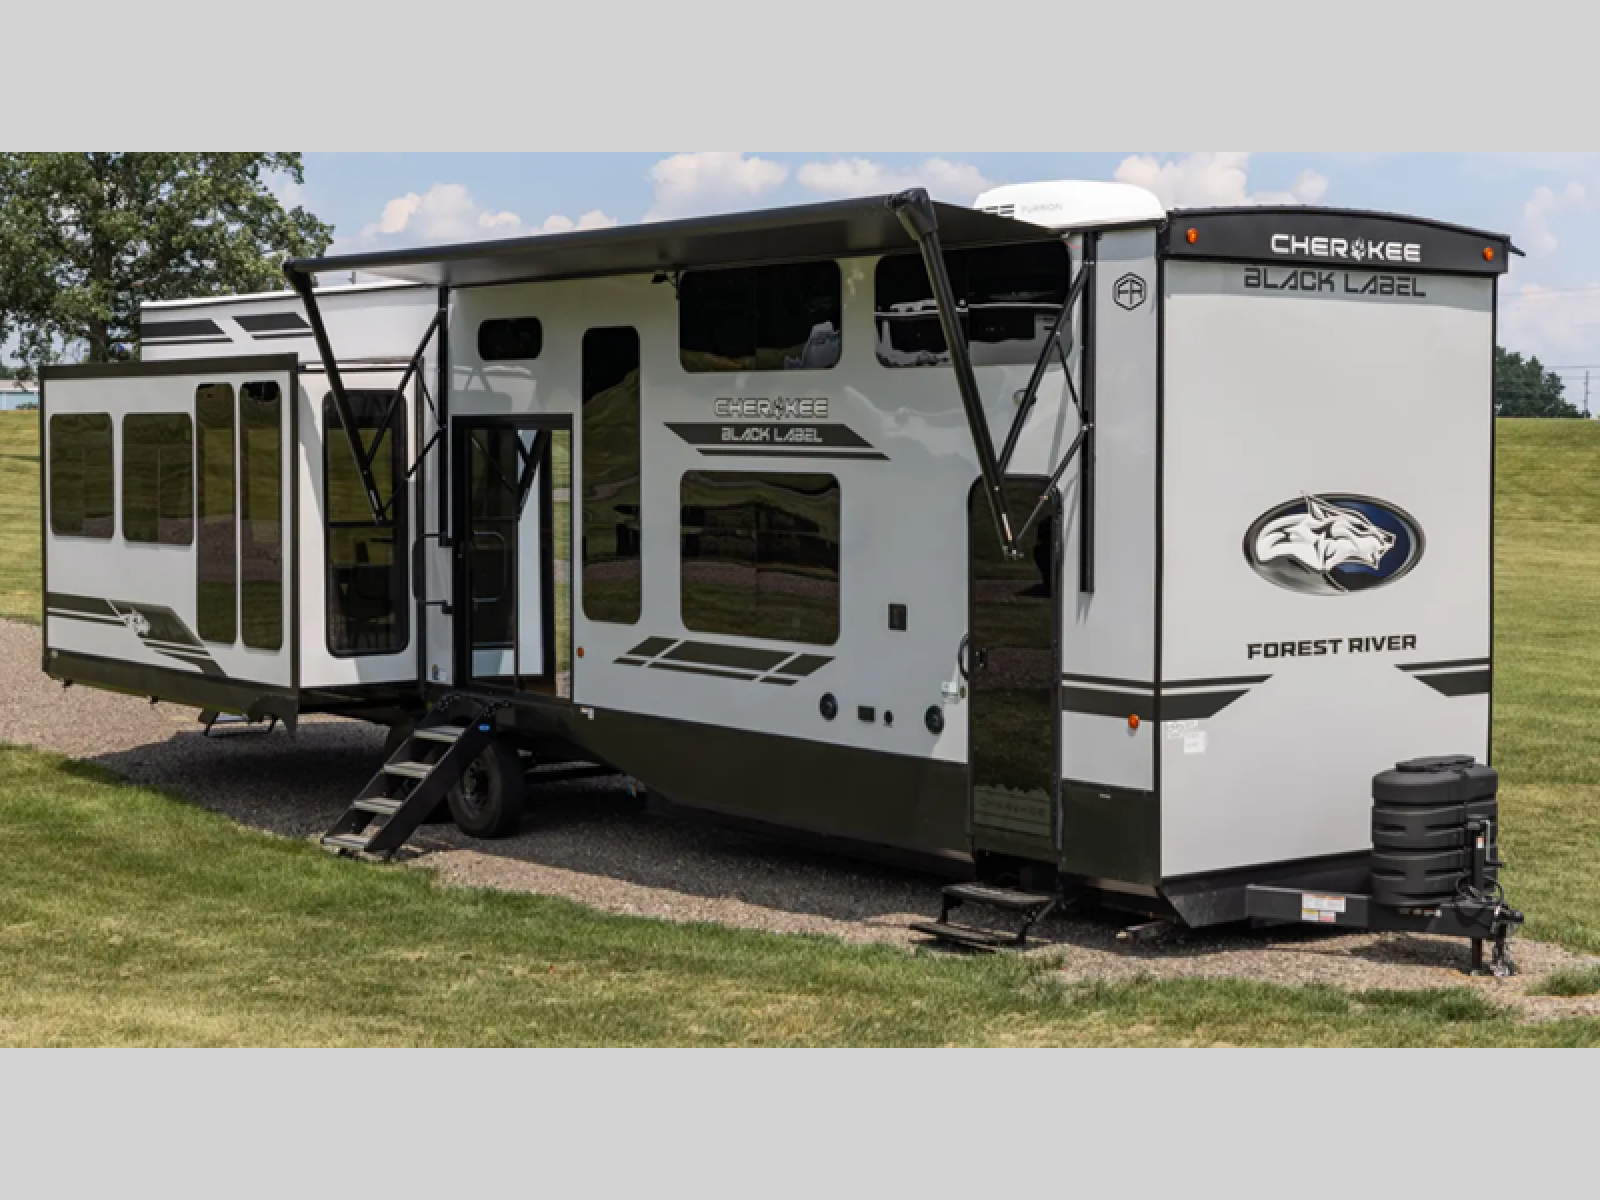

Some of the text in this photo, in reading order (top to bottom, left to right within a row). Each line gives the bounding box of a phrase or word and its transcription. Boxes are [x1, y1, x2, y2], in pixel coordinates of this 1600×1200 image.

[1270, 234, 1422, 263] CHEROKEE
[1244, 267, 1427, 298] BLACK LABEL
[714, 396, 829, 420] CHEROKEE
[721, 426, 823, 443] BLACK LABEL
[1246, 633, 1418, 660] FOREST RIVER
